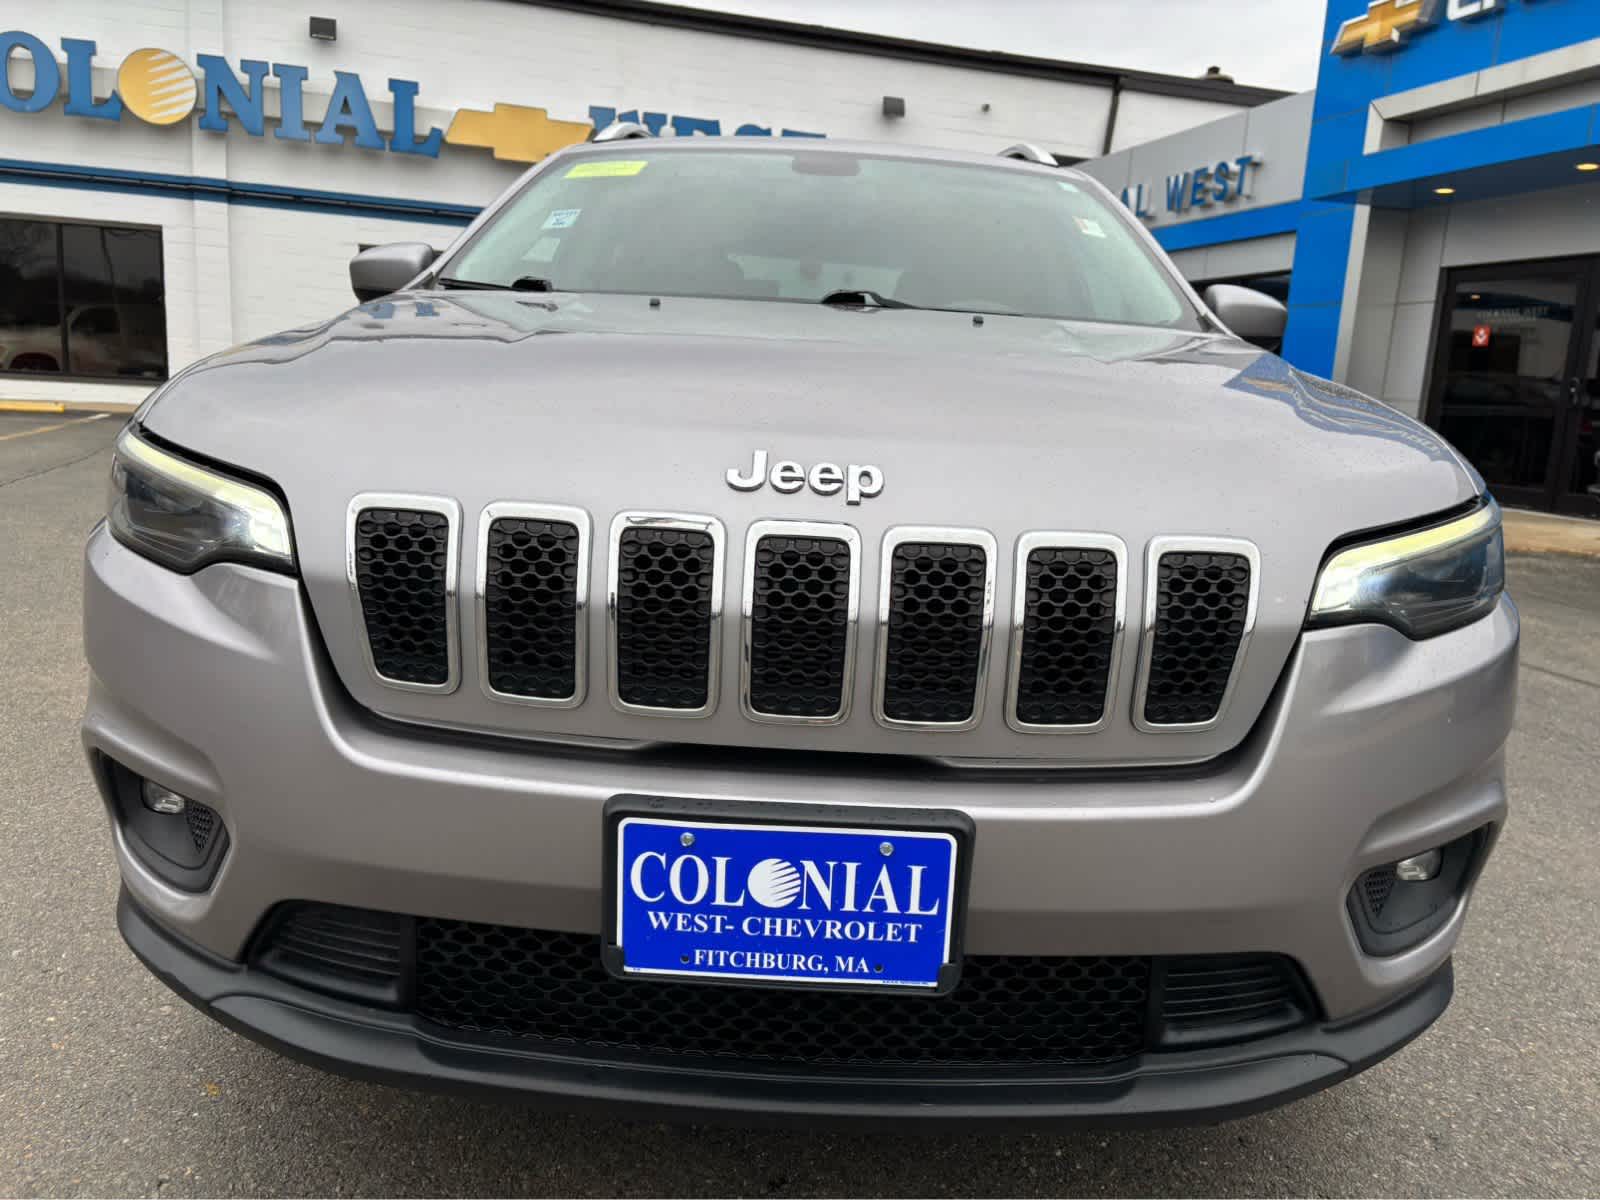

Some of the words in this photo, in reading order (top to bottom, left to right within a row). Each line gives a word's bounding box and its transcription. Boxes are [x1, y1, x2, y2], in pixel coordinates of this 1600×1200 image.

[1165, 155, 1260, 213] WEST
[726, 449, 884, 506] Jeep
[630, 851, 939, 916] COLONIAL
[742, 916, 922, 943] CHEVROLET
[693, 949, 829, 973] FITCHBURG,
[834, 955, 869, 973] MA
